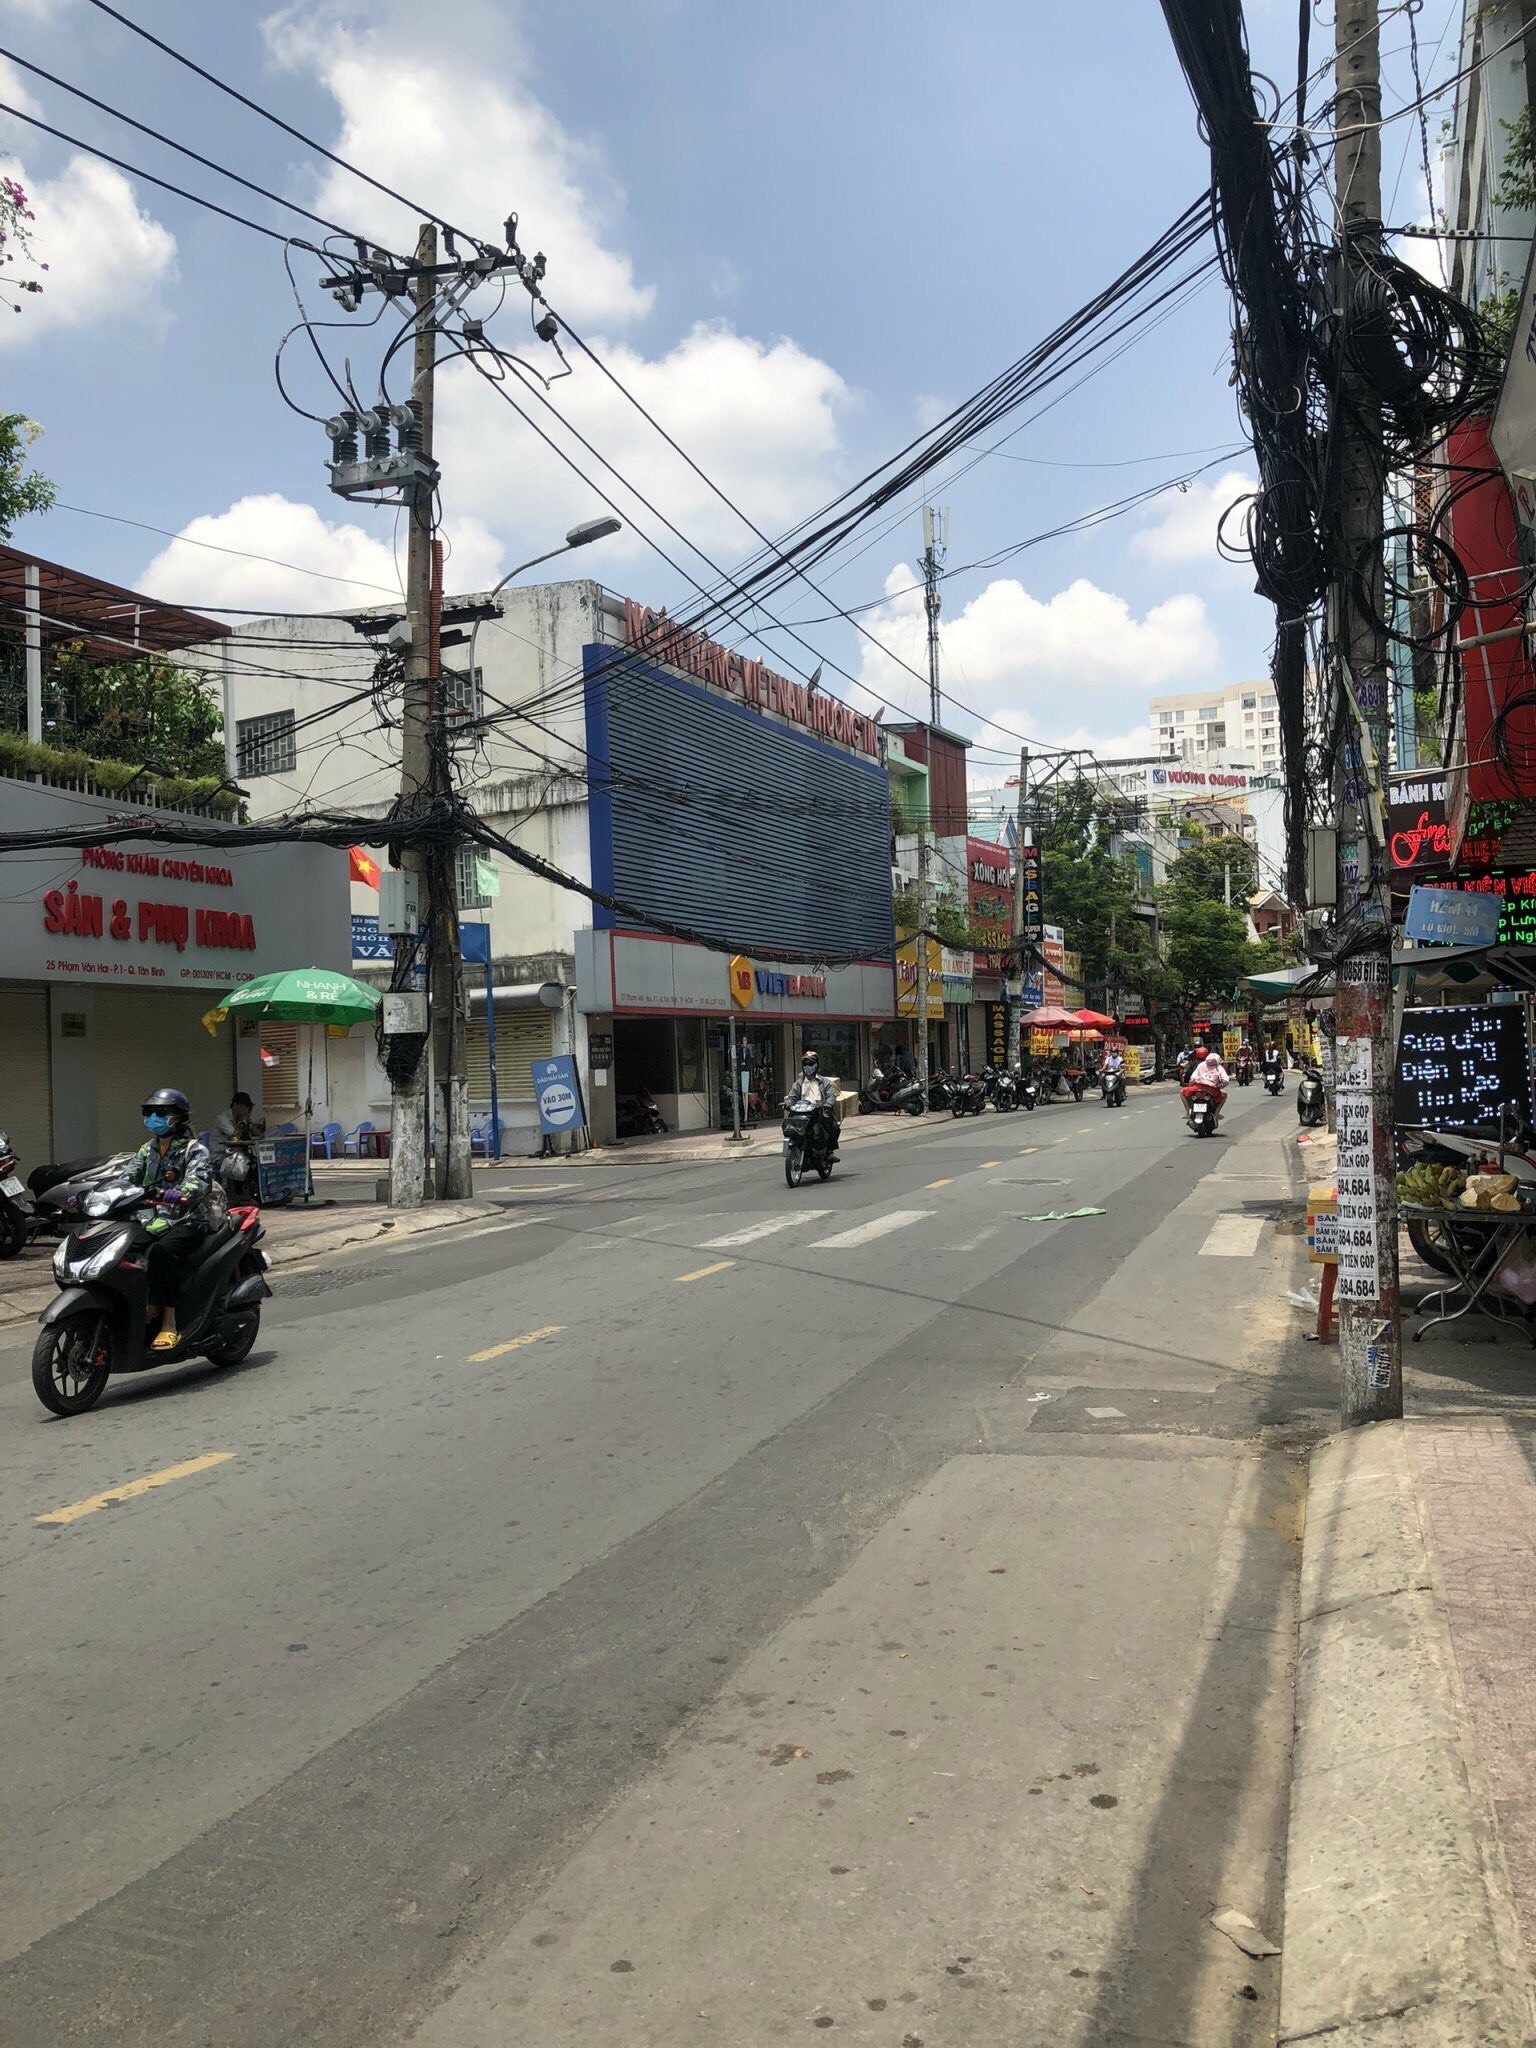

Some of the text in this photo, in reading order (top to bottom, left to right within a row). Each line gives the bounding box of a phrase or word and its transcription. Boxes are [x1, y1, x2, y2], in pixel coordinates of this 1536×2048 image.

[776, 673, 808, 727] NAM
[1168, 769, 1206, 785] VƯƠNG
[1209, 773, 1247, 788] QUANG
[1389, 781, 1429, 806] BÁNH
[204, 867, 233, 886] KHOA
[1023, 847, 1040, 923] MASSAGE
[44, 879, 257, 952] SẢN & PHỤ KHOA
[46, 959, 55, 970] 25
[296, 980, 346, 991] NHANH
[755, 968, 827, 998] VIETBANK
[306, 990, 317, 1000] &
[992, 1005, 1005, 1063] MASSAGE
[1357, 1202, 1373, 1219] GÓP
[1360, 1251, 1375, 1268] GÓP
